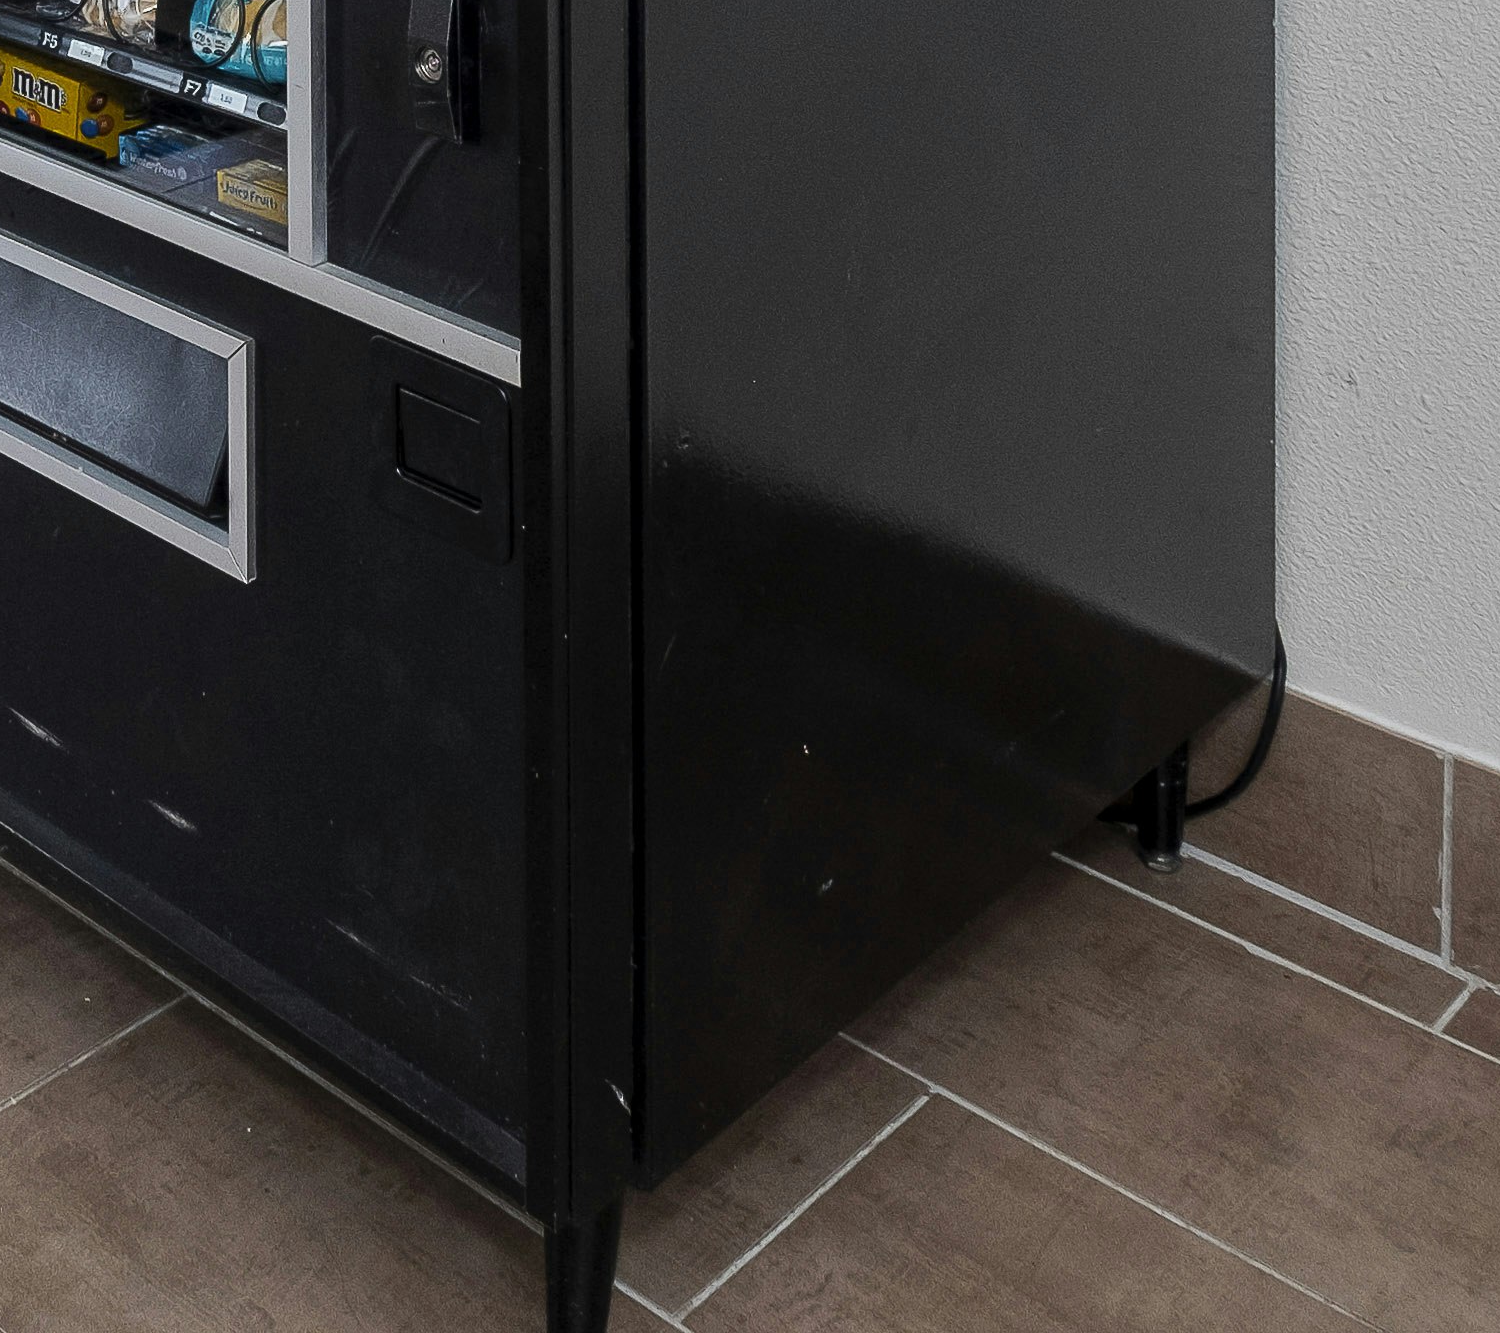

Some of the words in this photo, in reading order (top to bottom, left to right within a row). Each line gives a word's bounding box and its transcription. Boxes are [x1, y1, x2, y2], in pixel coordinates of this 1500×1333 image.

[42, 32, 58, 49] F5
[184, 79, 202, 97] F7
[222, 181, 249, 200] Juicy
[249, 192, 278, 210] Fruit
